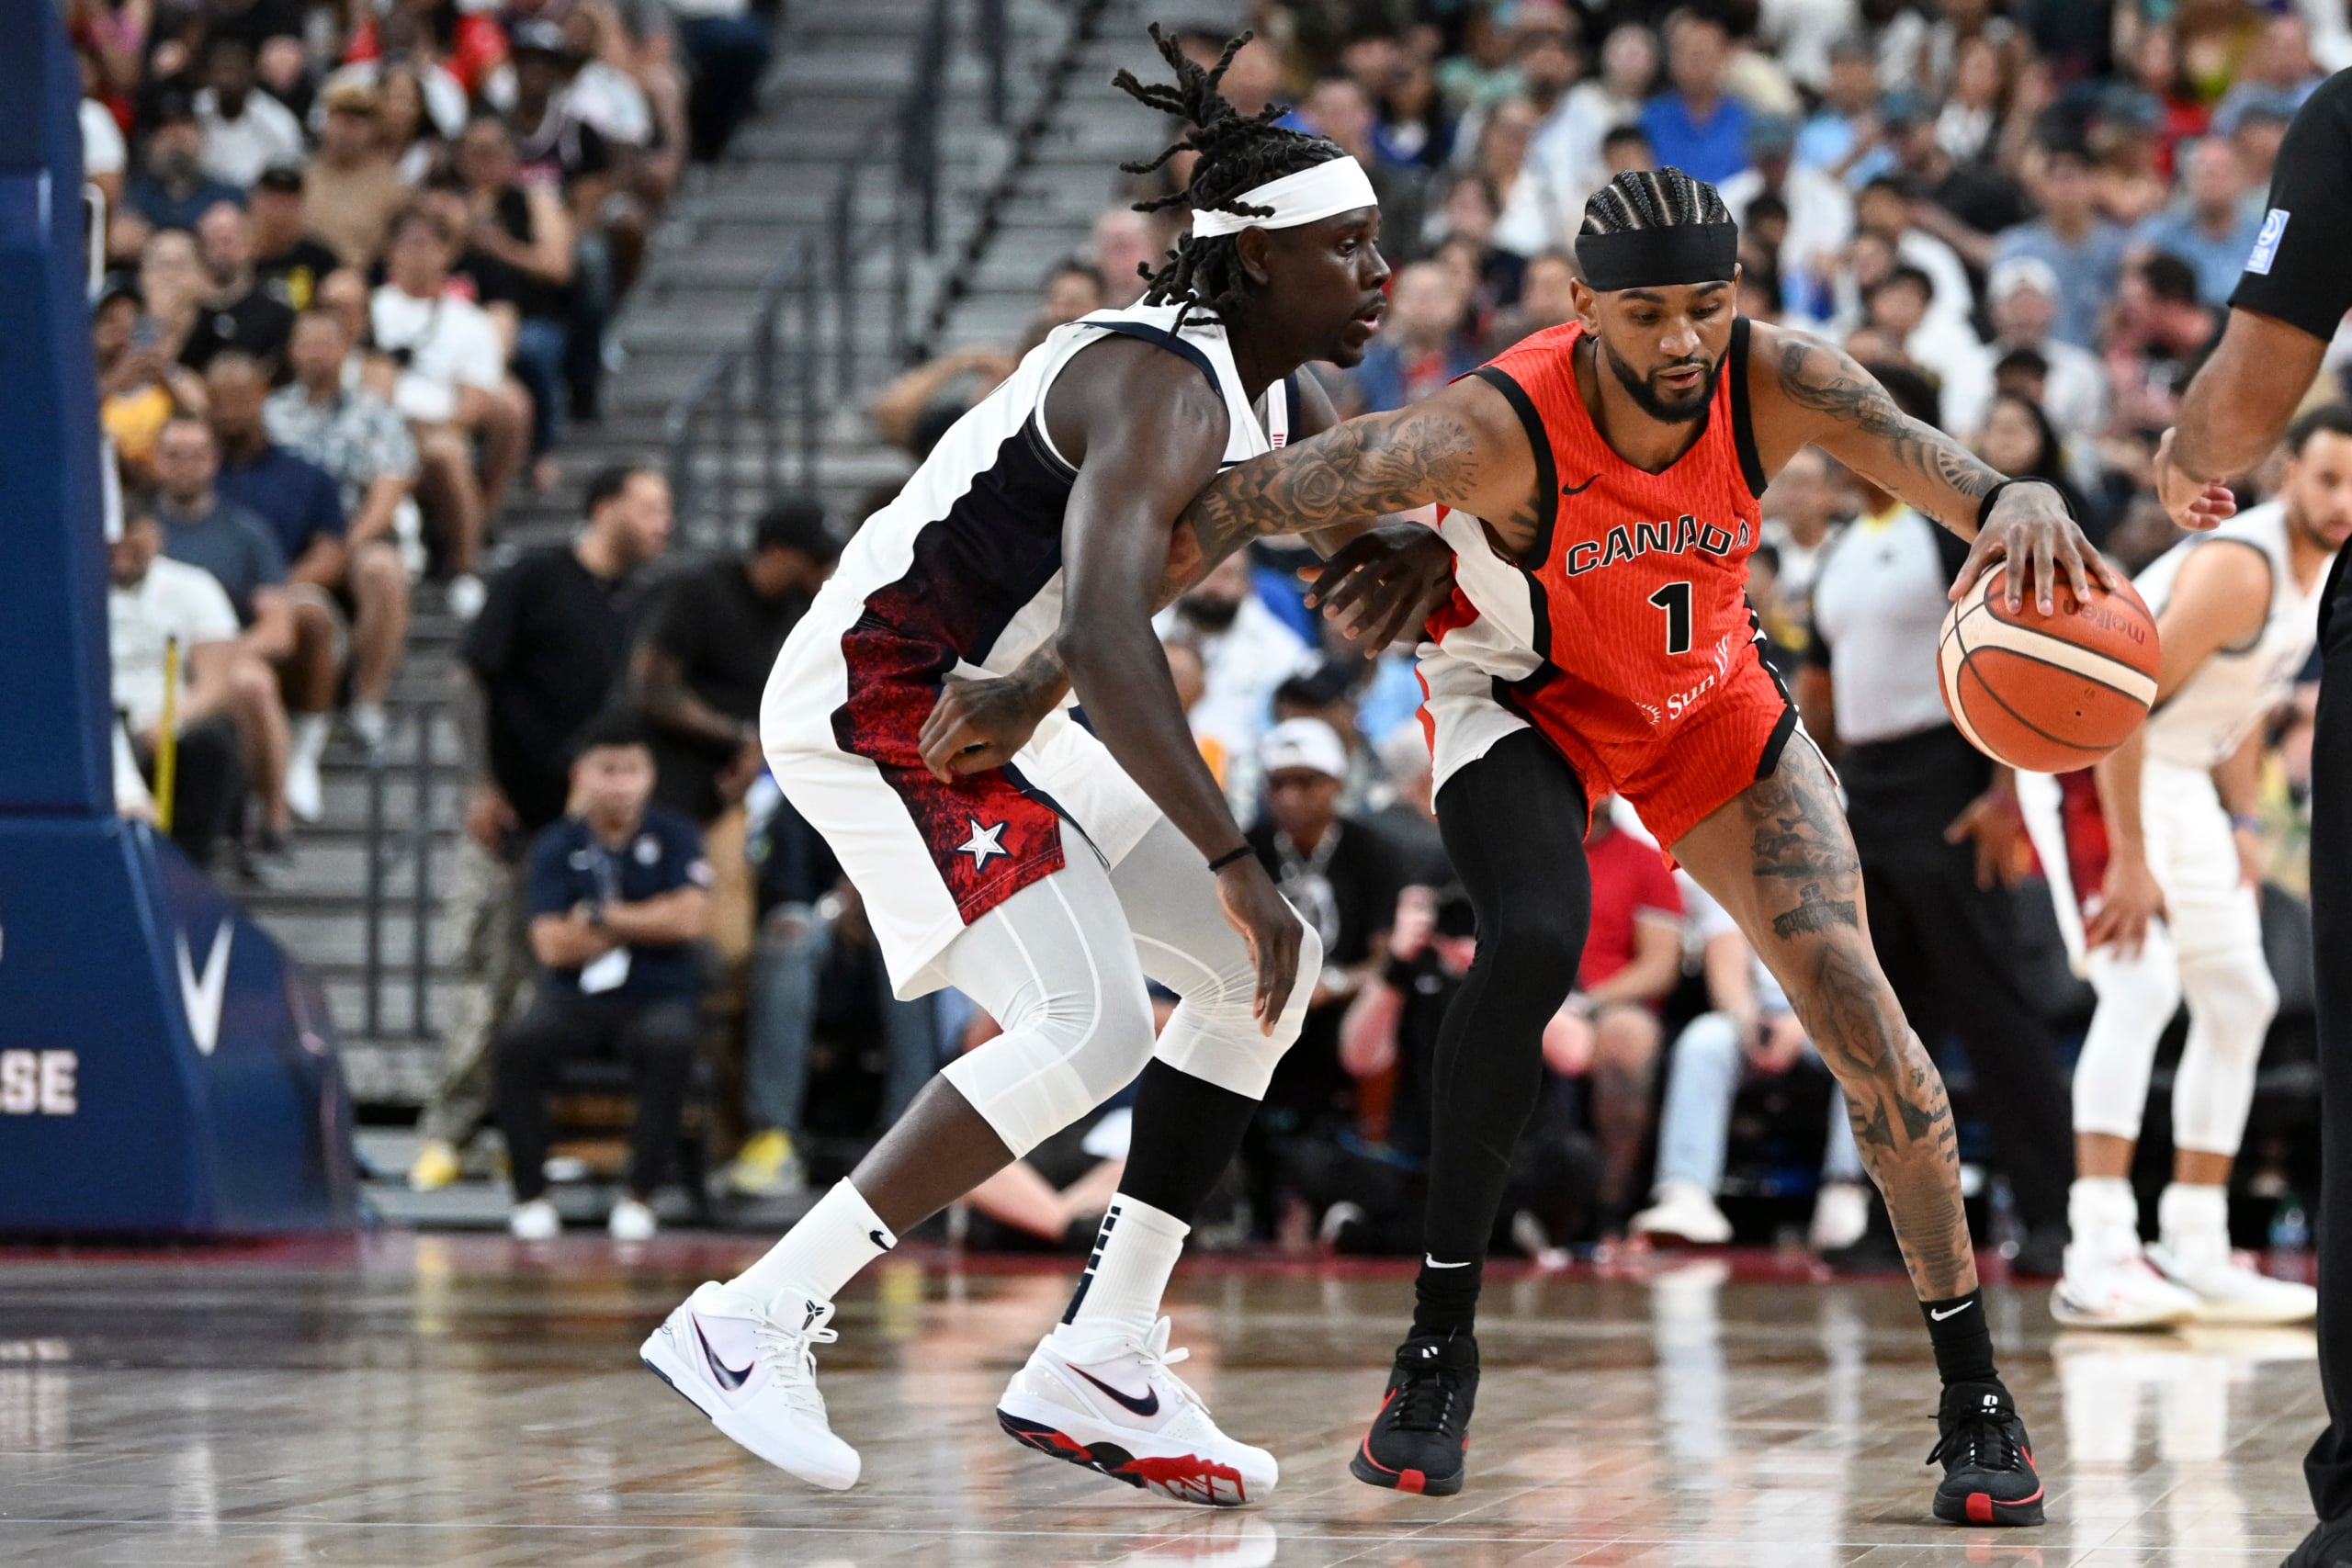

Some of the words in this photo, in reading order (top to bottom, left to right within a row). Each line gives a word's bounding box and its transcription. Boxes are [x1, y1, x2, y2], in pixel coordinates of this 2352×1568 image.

[1566, 514, 1749, 577] CANADA
[1647, 581, 1692, 656] 1
[2063, 597, 2146, 646] molten
[1667, 673, 1716, 720] Sun
[0, 1048, 79, 1115] SE
